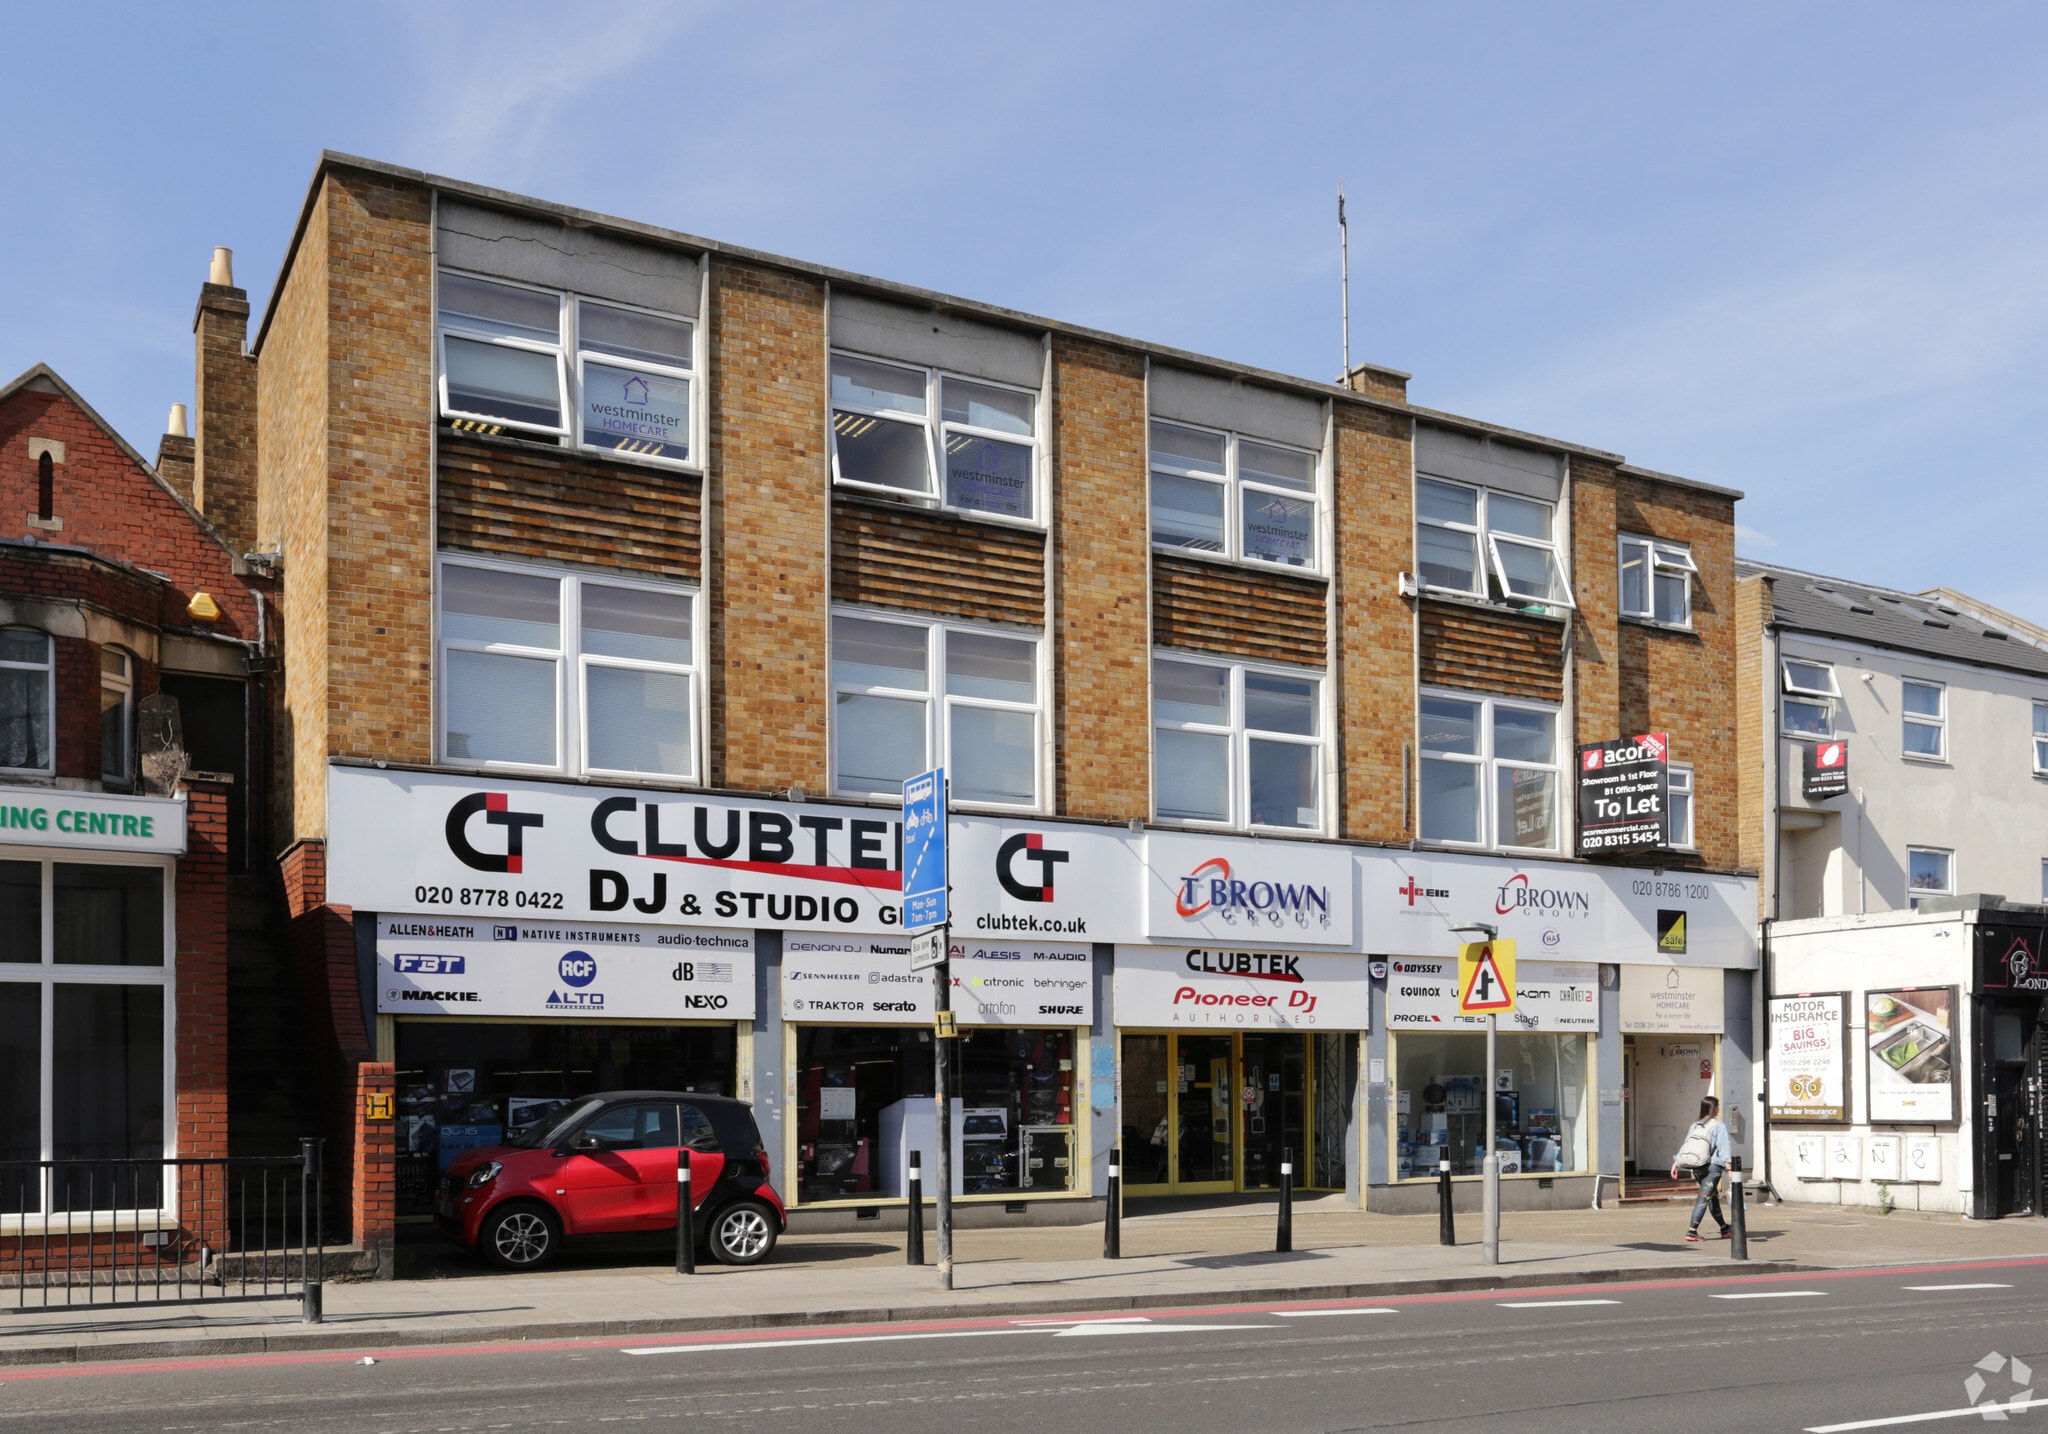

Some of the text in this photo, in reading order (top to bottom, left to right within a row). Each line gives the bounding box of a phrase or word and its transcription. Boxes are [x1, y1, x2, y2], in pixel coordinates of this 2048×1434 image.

[591, 403, 680, 427] westminster
[603, 418, 668, 437] HOMECARE
[952, 469, 1024, 489] westminster
[1248, 523, 1308, 541] westminster
[1641, 740, 1660, 757] OFFER
[1646, 735, 1665, 752] UNDER
[1582, 776, 1619, 786] Showroom
[1620, 774, 1626, 782] &
[1639, 770, 1658, 779] Floor
[1604, 782, 1659, 796] B1 Office Space
[1594, 794, 1660, 818] To Let
[56, 810, 153, 837] CENTRE
[1583, 822, 1660, 836] acorncommercial.co.uk
[591, 797, 902, 872] CLUBTE
[906, 832, 916, 844] taxi
[1583, 831, 1660, 848] 020 8315 5454
[589, 869, 667, 914] DJ
[680, 894, 702, 915] &
[715, 891, 859, 924] STUDIO
[1210, 879, 1326, 911] BROWN
[1633, 881, 1709, 900] 020 8786 1200
[415, 886, 564, 910] 020 8778 0422
[912, 897, 937, 911] Mon-Sun
[1517, 888, 1589, 910] BROWN
[911, 909, 937, 923] 7am-7pm
[1221, 908, 1327, 924] GROUP
[1524, 908, 1589, 919] GROUP
[976, 913, 1087, 933] clubtek.co.uk
[389, 924, 474, 938] ALLEN&HEATH
[522, 929, 561, 940] NATIVE
[566, 931, 640, 943] INSTRUMENTS
[1665, 936, 1683, 945] safe
[790, 943, 862, 953] DENON DJ
[870, 945, 911, 955] Numar
[972, 949, 1021, 960] ALESIS
[399, 955, 461, 973] FBT
[1033, 953, 1086, 961] M-AUDIO
[561, 960, 594, 977] RCF
[672, 962, 694, 981] dB
[1186, 949, 1304, 983] CLUBTEK
[1404, 964, 1442, 973] ODYSSEY
[881, 974, 923, 983] adastra
[983, 977, 1024, 987] citronic
[1033, 978, 1087, 991] behringer
[546, 990, 604, 1004] ALTO
[1173, 986, 1278, 1006] Pioneer
[1401, 987, 1440, 997] EQUINOX
[1650, 991, 1695, 1000] westminster
[685, 995, 728, 1010] NEXO
[809, 1001, 864, 1011] TRAKTOR
[873, 1001, 916, 1012] serato
[978, 1001, 1016, 1015] ortofon
[1784, 1001, 1825, 1012] MOTOR
[1038, 1006, 1083, 1014] SHURE
[1771, 1011, 1838, 1023] INSURANCE
[1173, 1013, 1316, 1024] AUTHORISED
[1514, 1014, 1539, 1027] Stagg
[1793, 1028, 1815, 1041] BIG
[1784, 1038, 1827, 1052] SAVINGS
[1783, 1107, 1802, 1115] Wiser
[1804, 1107, 1837, 1115] Insurance
[441, 1127, 478, 1136] Qu-16
